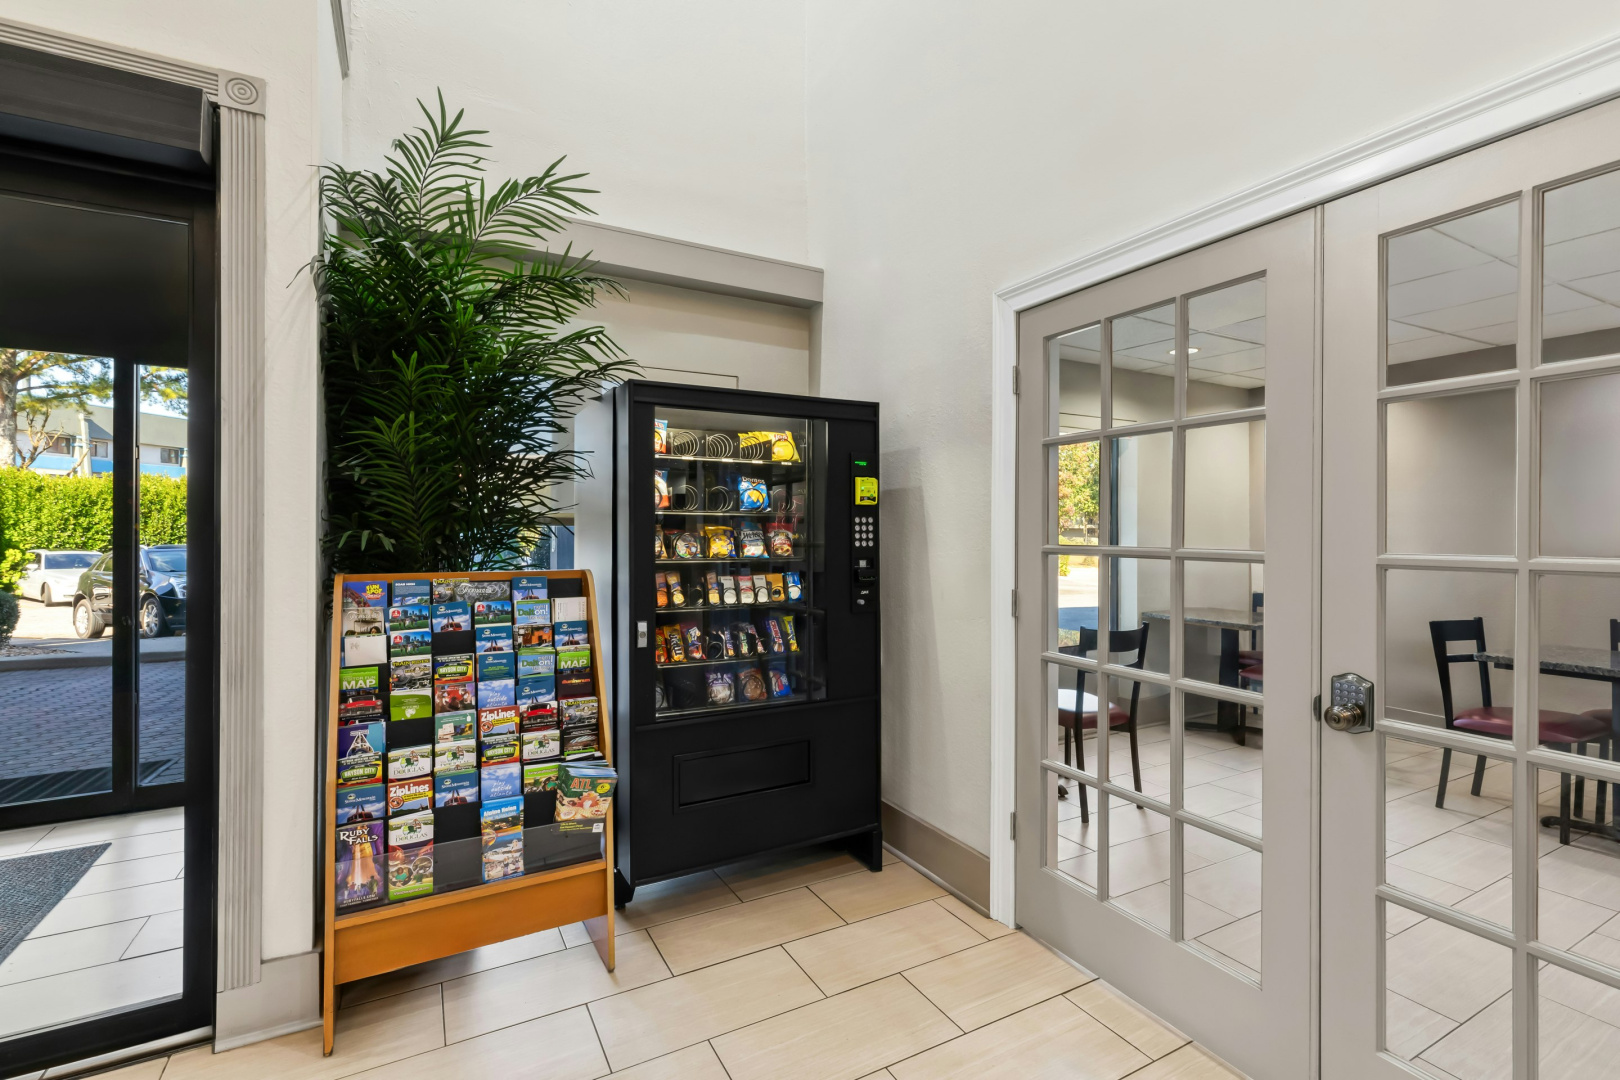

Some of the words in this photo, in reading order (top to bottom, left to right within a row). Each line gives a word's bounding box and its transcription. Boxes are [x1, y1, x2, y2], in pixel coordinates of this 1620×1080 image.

[561, 660, 587, 669] MAP
[343, 679, 376, 690] MAP
[481, 710, 516, 722] ZipLines
[570, 777, 592, 790] ATL
[390, 784, 430, 797] ZipLines
[340, 827, 370, 842] RUBY
[349, 835, 379, 846] FALLS
